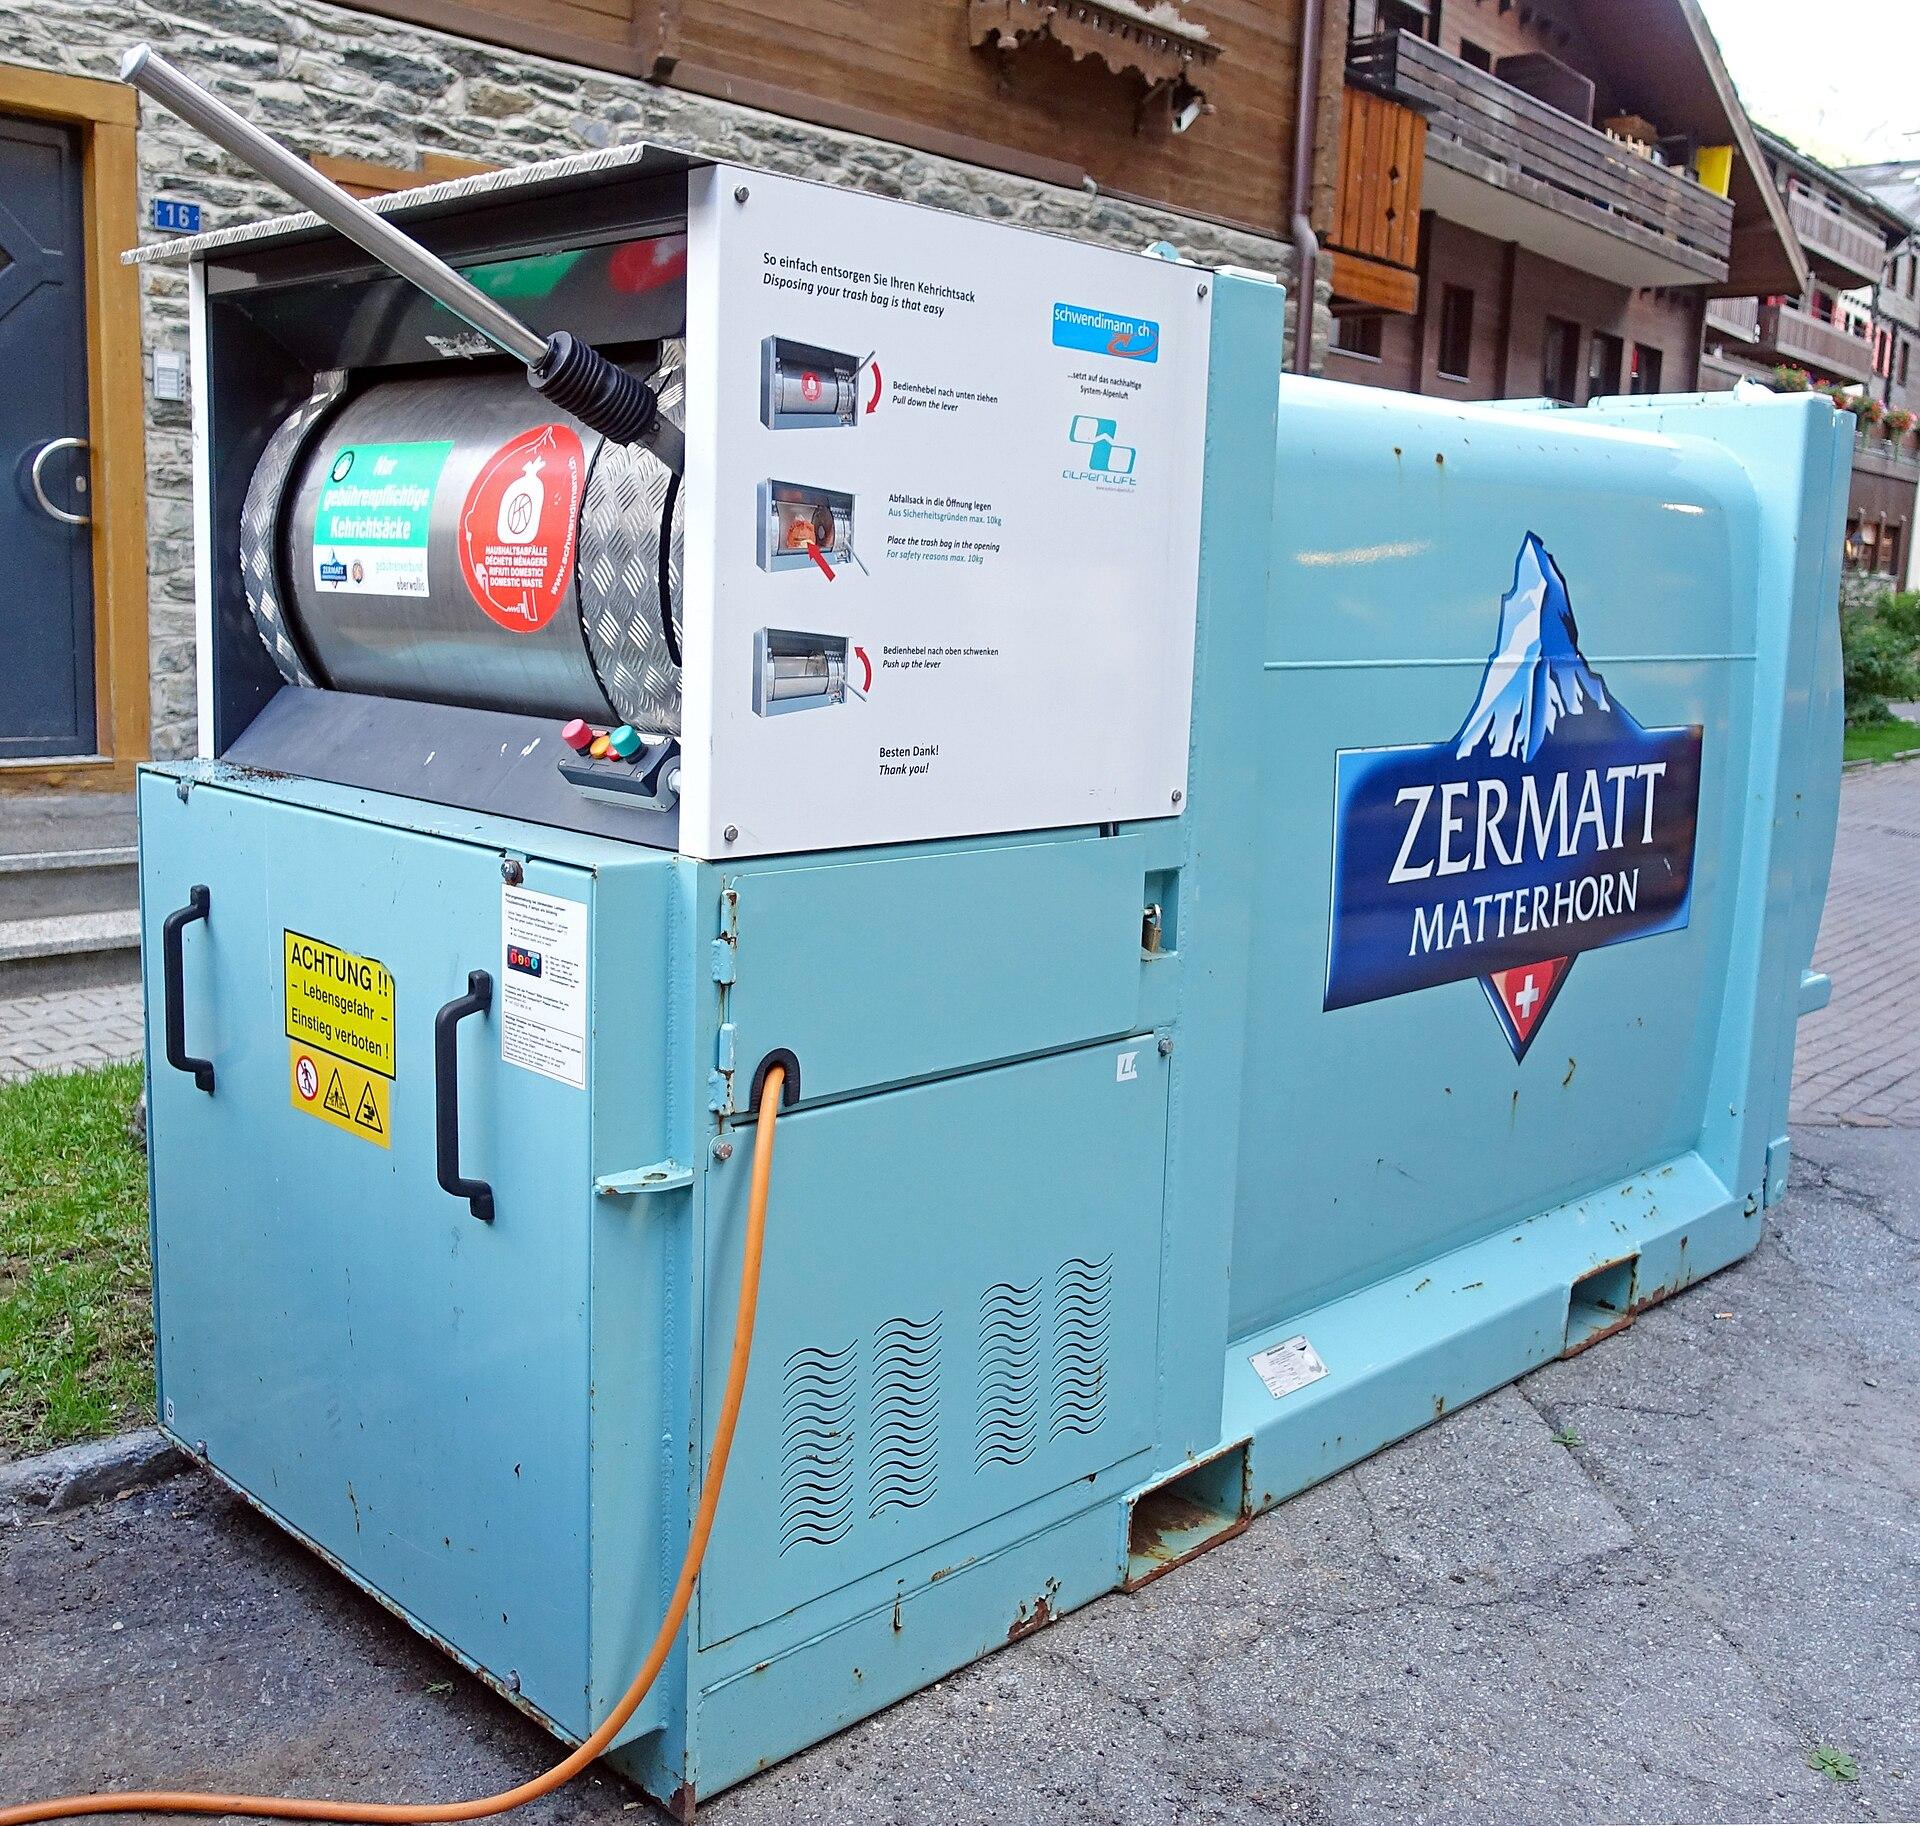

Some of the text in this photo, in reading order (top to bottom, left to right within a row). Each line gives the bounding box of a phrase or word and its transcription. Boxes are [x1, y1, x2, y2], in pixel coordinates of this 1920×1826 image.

[166, 204, 189, 228] 16
[763, 253, 975, 303] So einfach entsorgen Sie Ihren Kehrichtsack
[763, 273, 944, 317] Disposing your trash bag is that easy
[1099, 375, 1108, 383] das
[1110, 377, 1141, 390] nachhaltige
[893, 381, 998, 403] Bedienhebel nach unten ziehen
[1080, 385, 1128, 400] System-Alpenluft
[892, 395, 958, 411] Pull down the lever
[323, 484, 430, 512] gebührenpflichtige
[889, 494, 991, 511] Abfallsack in die Öffnung legen
[551, 456, 576, 595] www.schwendimann.ch
[888, 508, 1001, 526] Aus Sicherheitsgründen max. 10kg
[330, 516, 411, 539] Kehrichtsäcke
[485, 544, 547, 555] HAUSHALTSABFÄLLE
[887, 535, 1000, 552] Place the trash bag in the opening
[485, 555, 547, 567] DÉCHETS MÉNAGERS
[887, 550, 898, 558] For
[899, 551, 921, 561] safety
[922, 553, 948, 561] reasons
[968, 555, 983, 564] 10kg
[489, 567, 544, 577] RIFIUTI DOMESTICI
[396, 577, 425, 591] oberwallis
[490, 578, 542, 588] DOMESTIC WASTE
[884, 646, 999, 655] Bedienhebel nach oben schwenken
[883, 660, 941, 669] Push up the lever
[880, 745, 939, 757] Besten Dank!
[880, 763, 929, 776] Thank you!
[1388, 762, 1666, 884] ZERMATT
[1408, 868, 1640, 956] MATTERHORN
[291, 942, 372, 991] ACHTUNG
[303, 980, 375, 1021] Lebensgefahr
[292, 1008, 331, 1040] Einstieg
[335, 1026, 382, 1057] verboten
[168, 1404, 173, 1417] S
